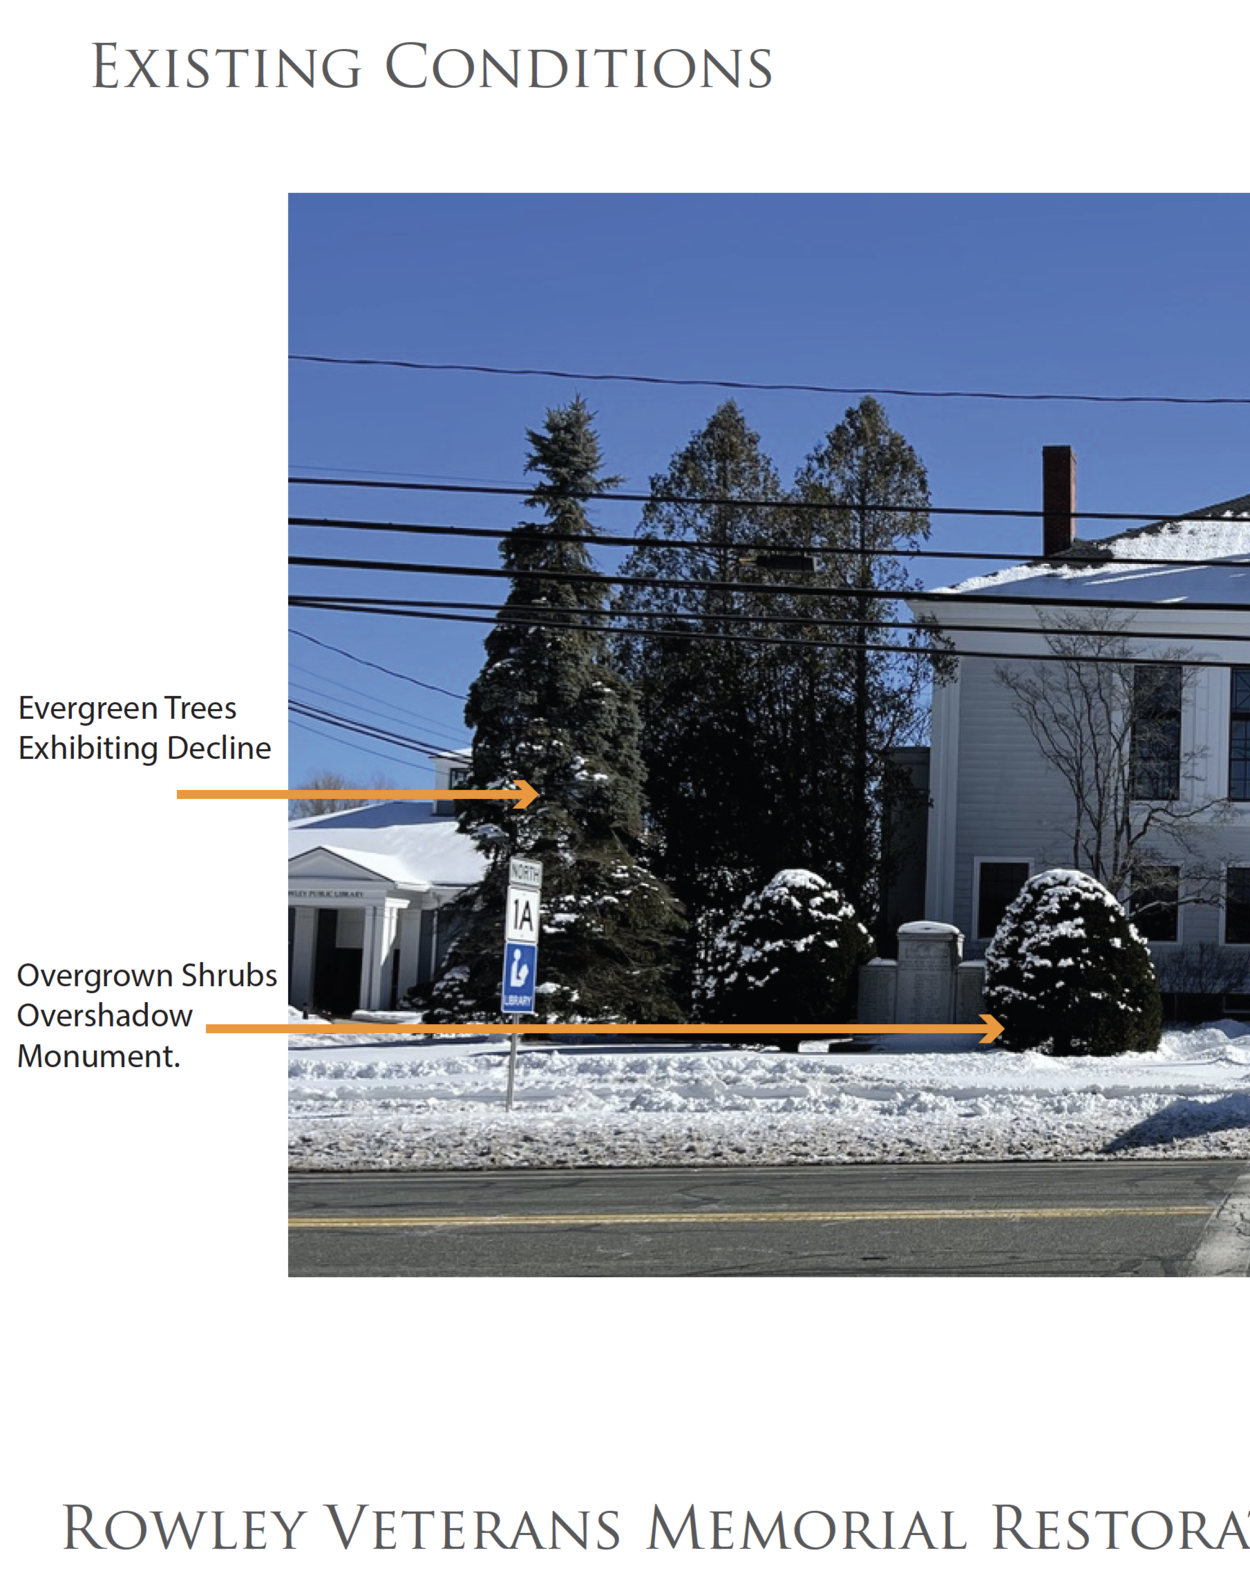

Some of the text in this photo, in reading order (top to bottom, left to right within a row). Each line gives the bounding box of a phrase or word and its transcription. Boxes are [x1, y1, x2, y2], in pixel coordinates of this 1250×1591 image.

[512, 863, 539, 882] NORTH
[513, 899, 534, 932] 1A
[504, 995, 532, 1006] LIBRARY
